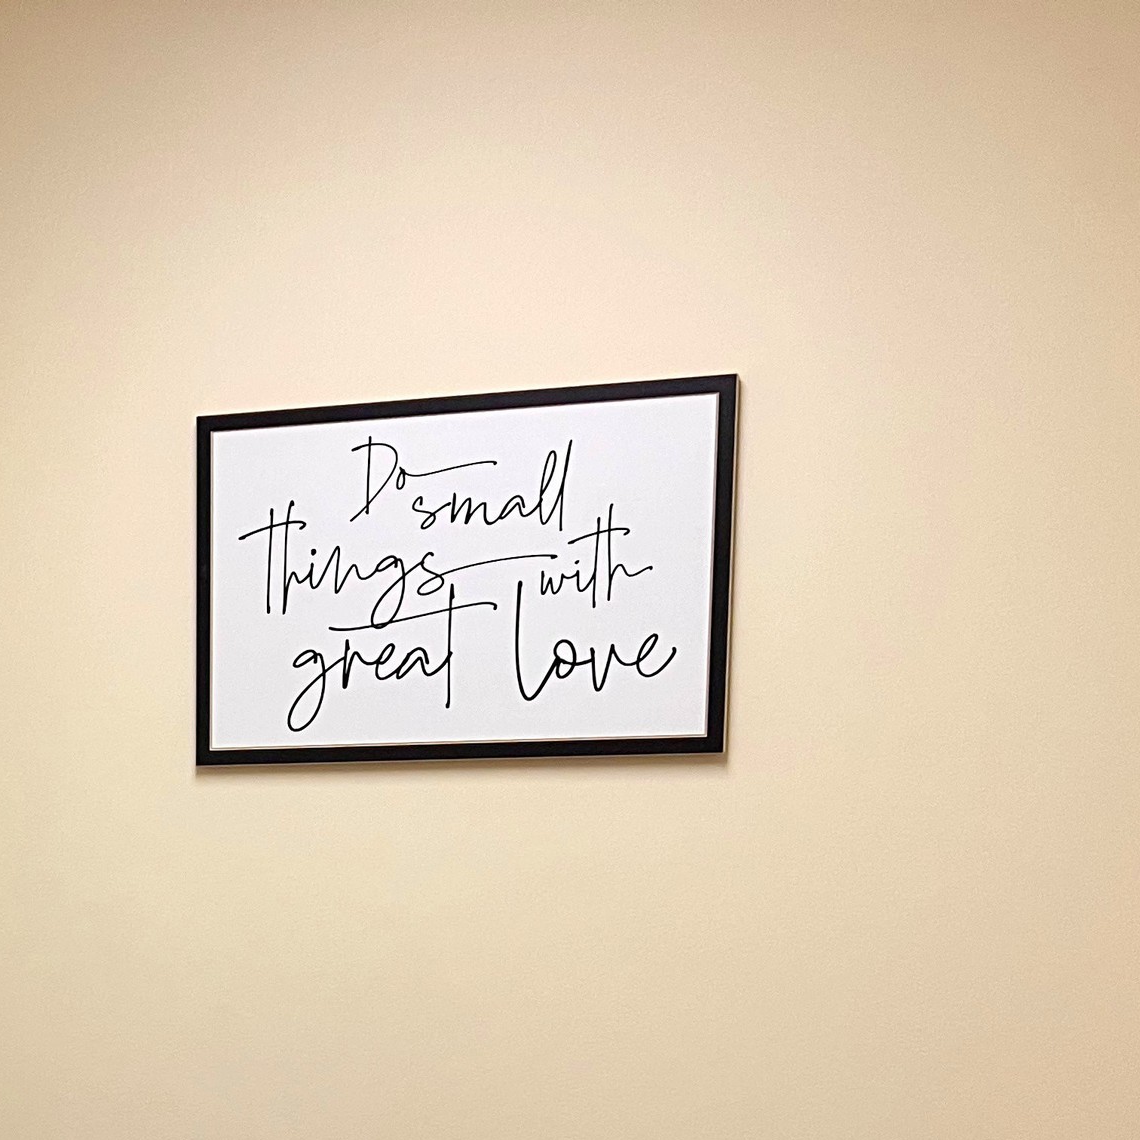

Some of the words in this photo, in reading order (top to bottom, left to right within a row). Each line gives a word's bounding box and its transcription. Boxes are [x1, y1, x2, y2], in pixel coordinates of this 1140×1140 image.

[350, 436, 497, 522] Do
[412, 440, 573, 532] small
[238, 500, 558, 629] things
[539, 503, 653, 608] with
[287, 583, 497, 732] great
